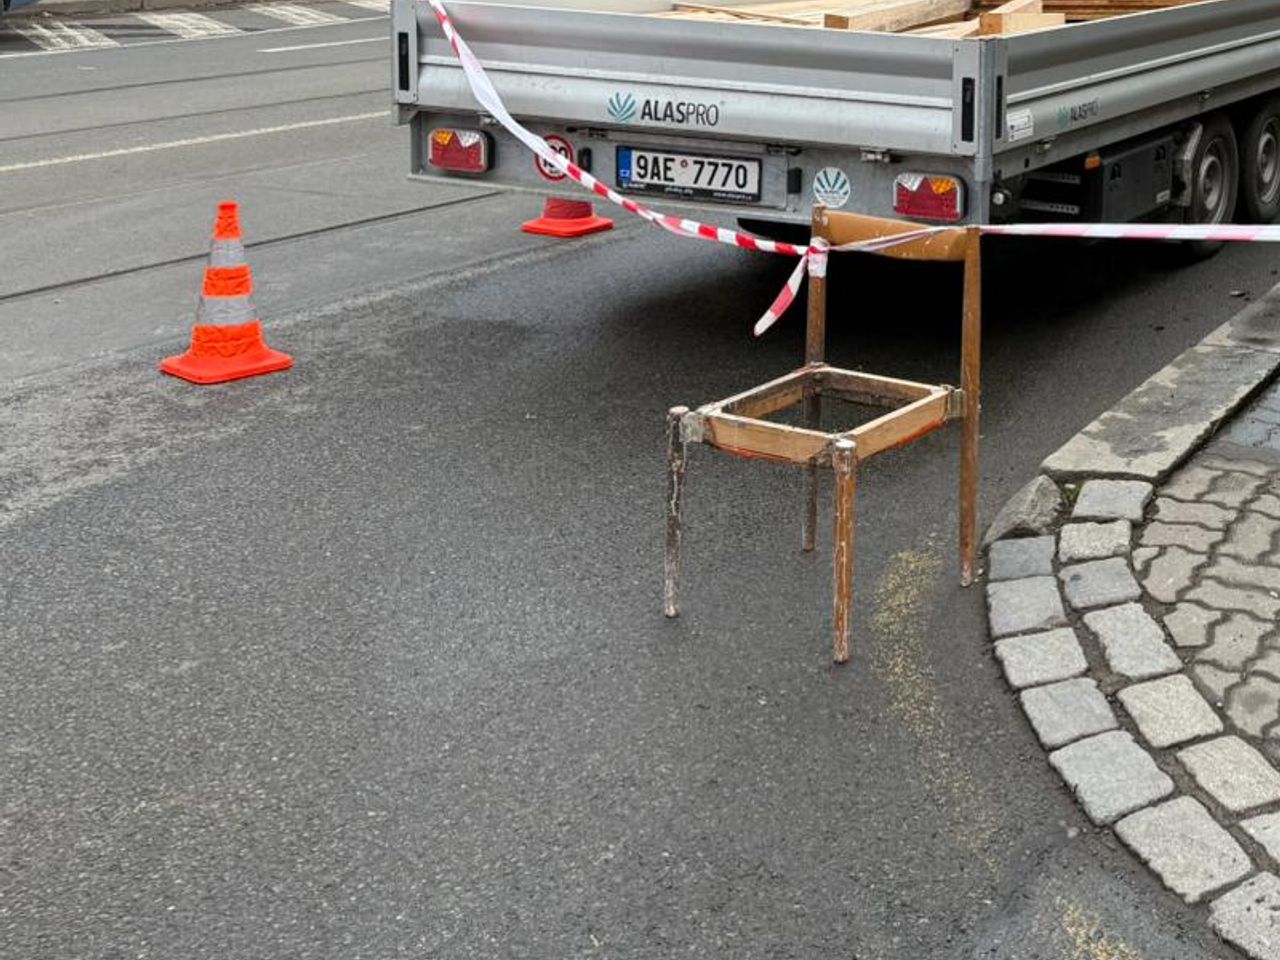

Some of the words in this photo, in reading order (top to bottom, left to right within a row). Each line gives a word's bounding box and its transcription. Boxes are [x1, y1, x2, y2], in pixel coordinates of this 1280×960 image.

[640, 100, 719, 126] ALASPRO
[636, 155, 675, 182] 9AE
[693, 160, 747, 189] 7770
